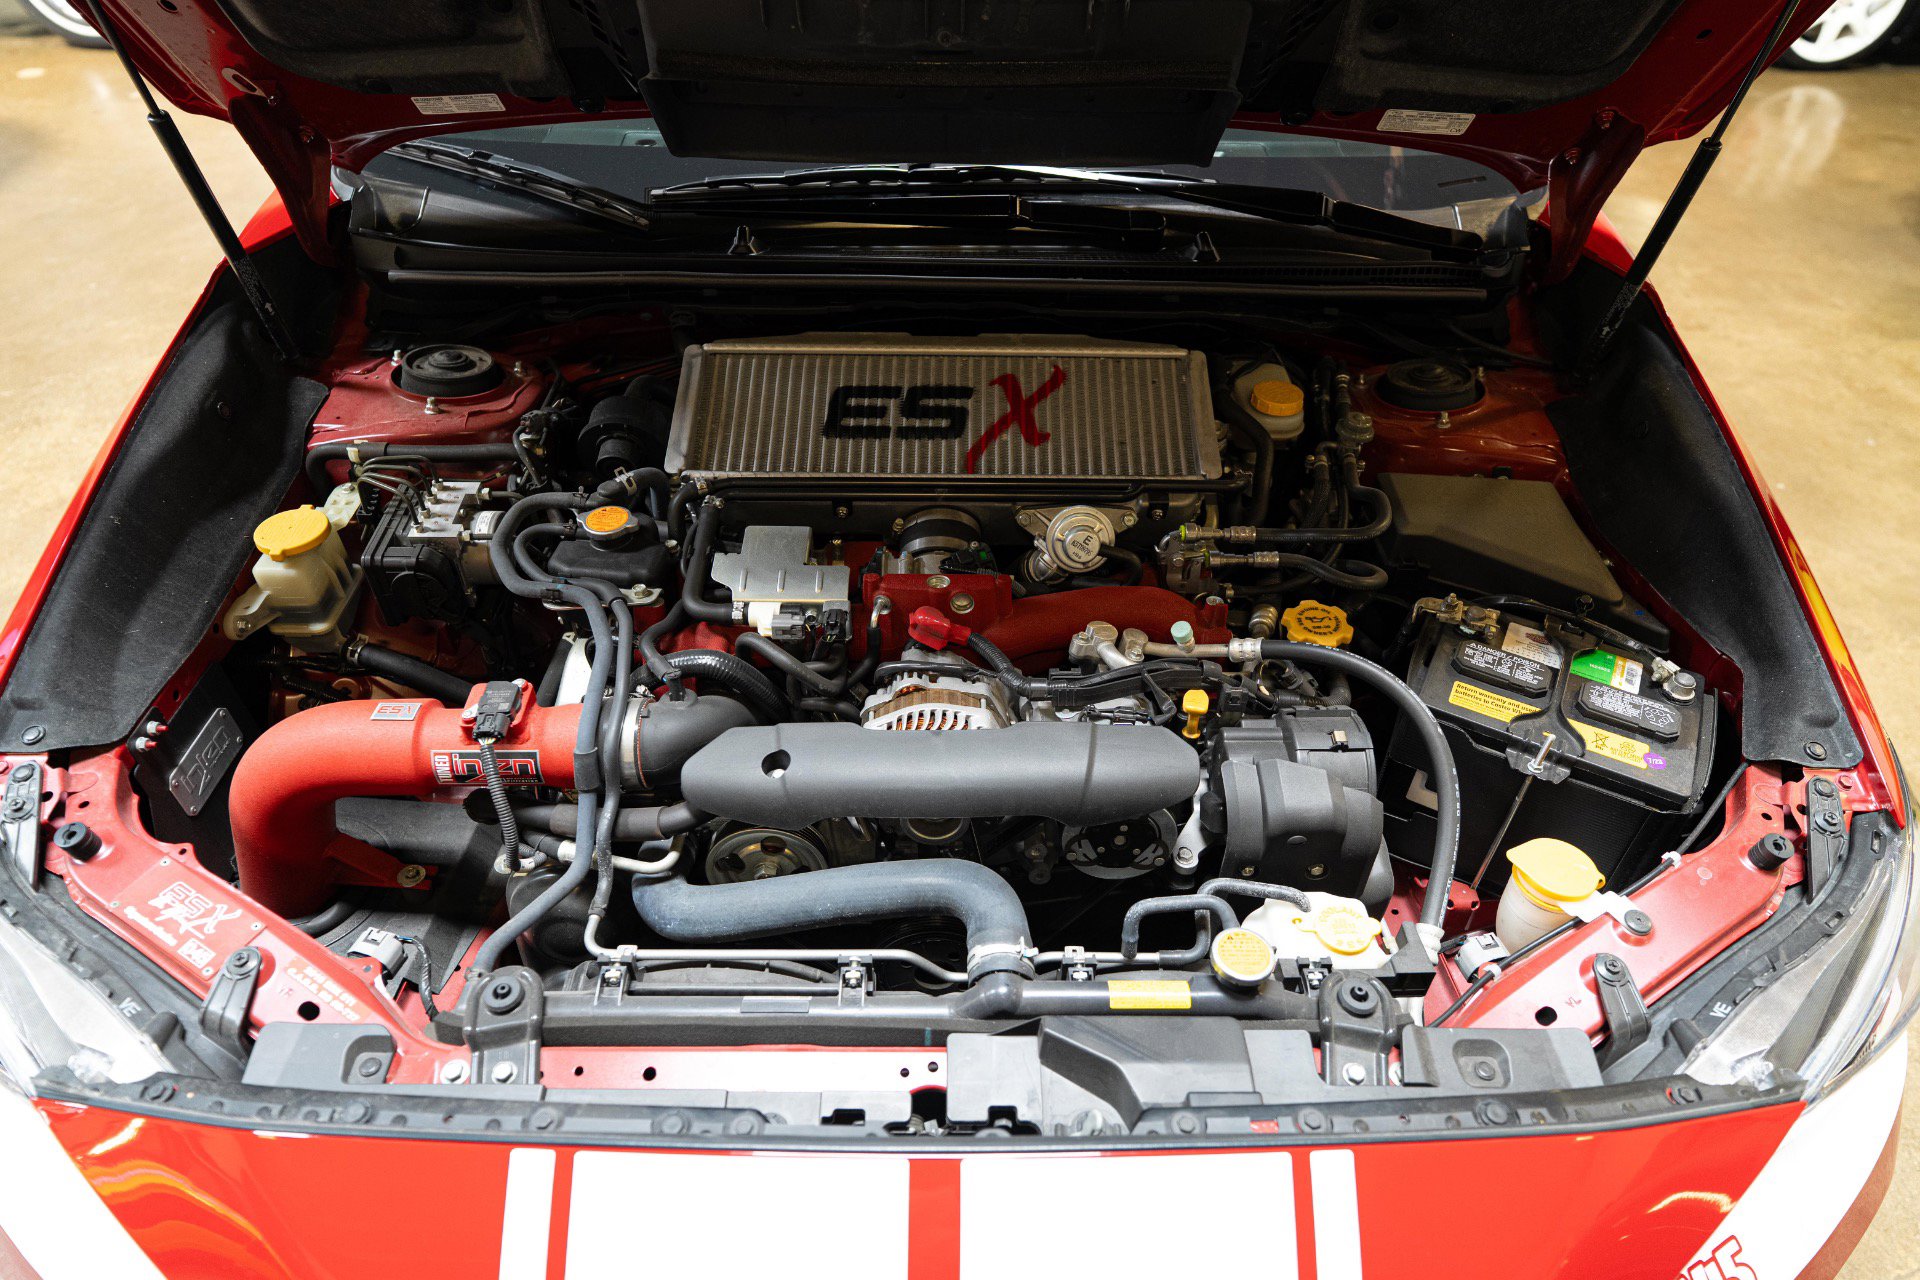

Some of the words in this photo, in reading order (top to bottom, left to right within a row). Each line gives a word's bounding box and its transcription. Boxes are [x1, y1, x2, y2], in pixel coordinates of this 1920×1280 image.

[822, 365, 1066, 474] ESX
[1082, 534, 1094, 546] E
[1454, 688, 1482, 702] batteries
[1456, 683, 1478, 695] Return
[1507, 700, 1521, 709] and
[434, 754, 454, 782] TUNED
[118, 996, 142, 1018] VE
[1708, 1001, 1731, 1018] VE
